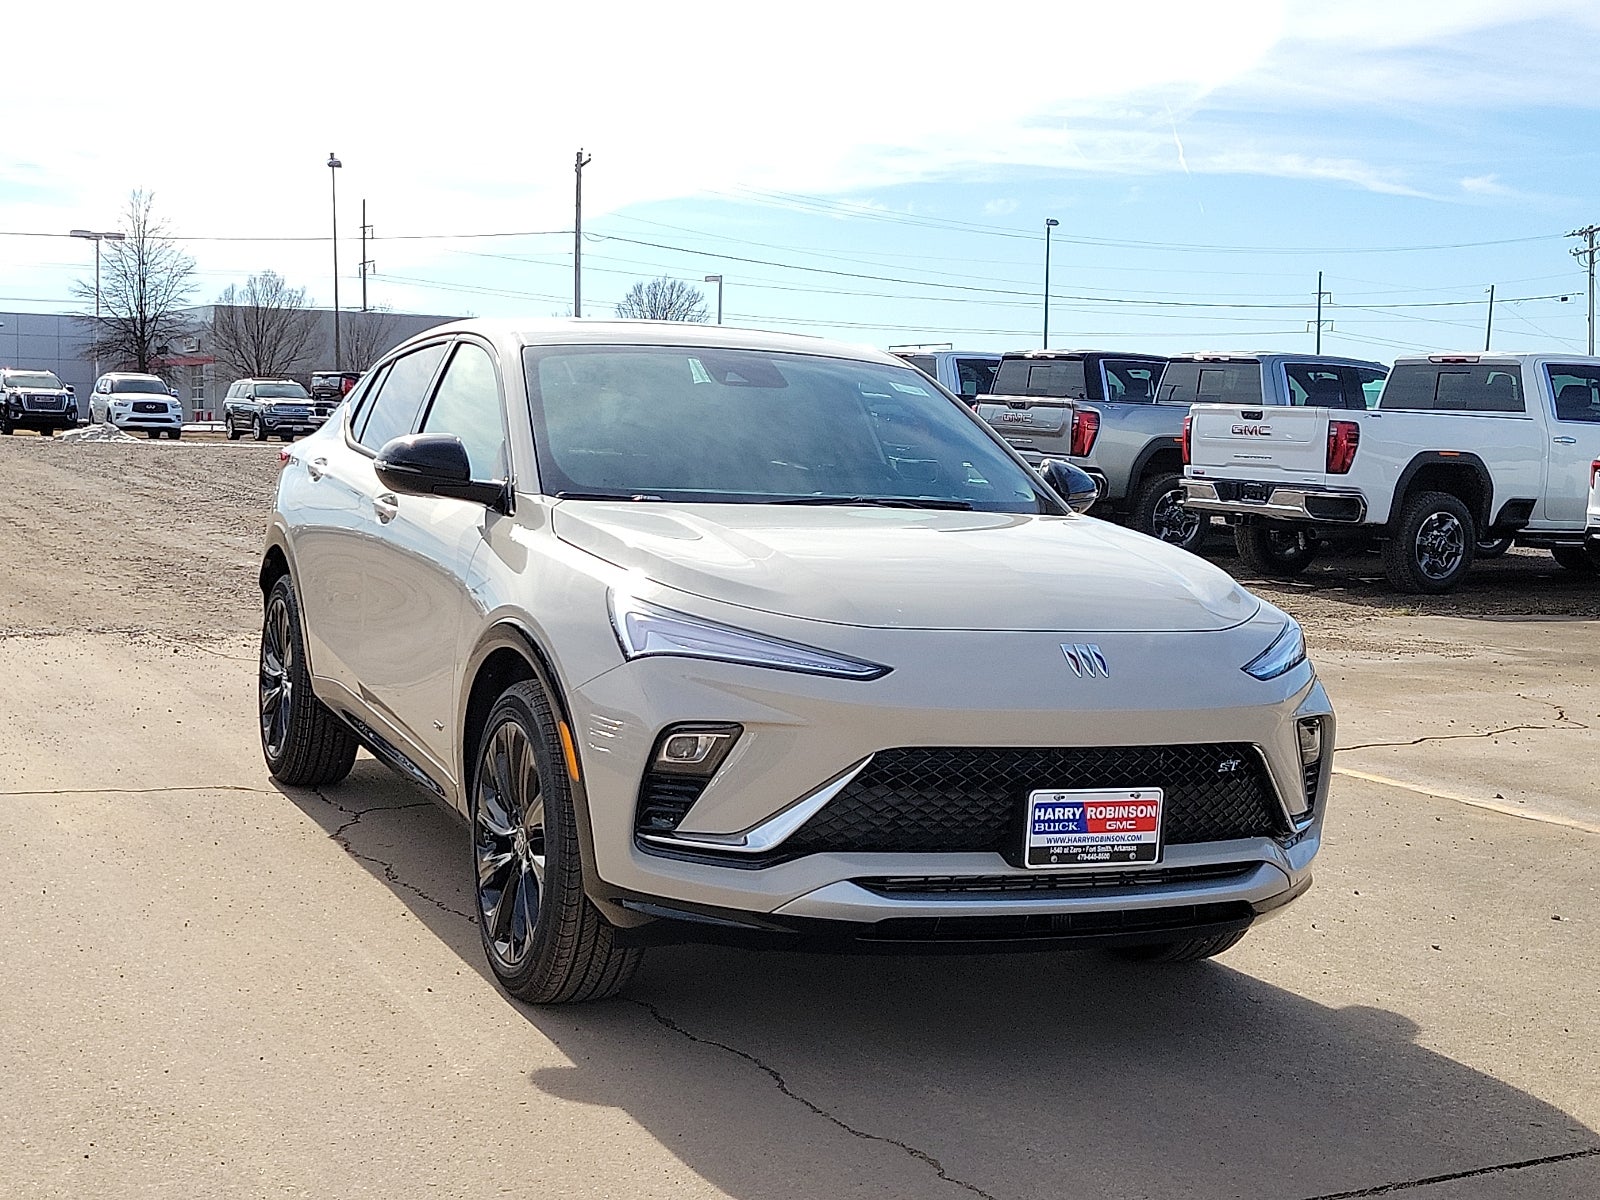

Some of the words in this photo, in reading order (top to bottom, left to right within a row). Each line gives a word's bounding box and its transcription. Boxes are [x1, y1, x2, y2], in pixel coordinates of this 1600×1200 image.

[1003, 412, 1033, 423] GMC
[1231, 424, 1272, 436] GMC
[1034, 807, 1083, 820] HARRY
[1086, 805, 1156, 819] ROBINSON
[1105, 820, 1137, 830] GMC
[1046, 834, 1142, 845] WWW.HARRYROBINSON.COM
